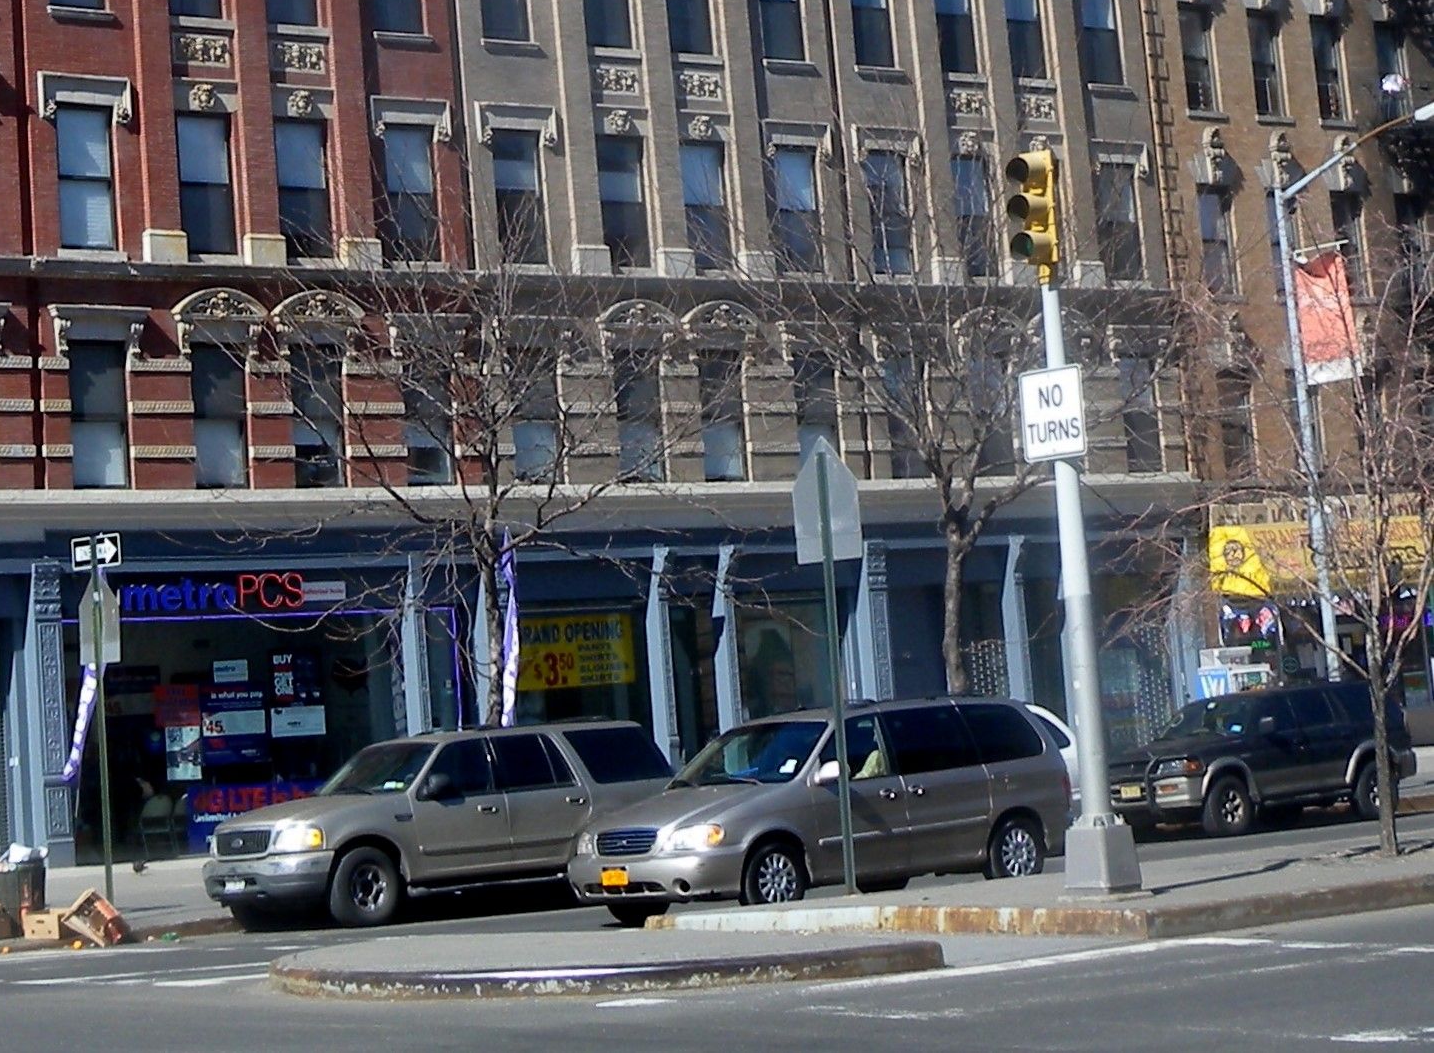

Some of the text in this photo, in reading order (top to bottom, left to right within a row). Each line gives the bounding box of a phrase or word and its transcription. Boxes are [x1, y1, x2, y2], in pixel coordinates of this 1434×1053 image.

[1038, 383, 1063, 409] NO
[1027, 417, 1081, 445] TURNS
[118, 571, 306, 612] metroPCS
[564, 619, 623, 643] OPENING
[273, 654, 293, 665] BUY
[228, 787, 265, 811] LTE
